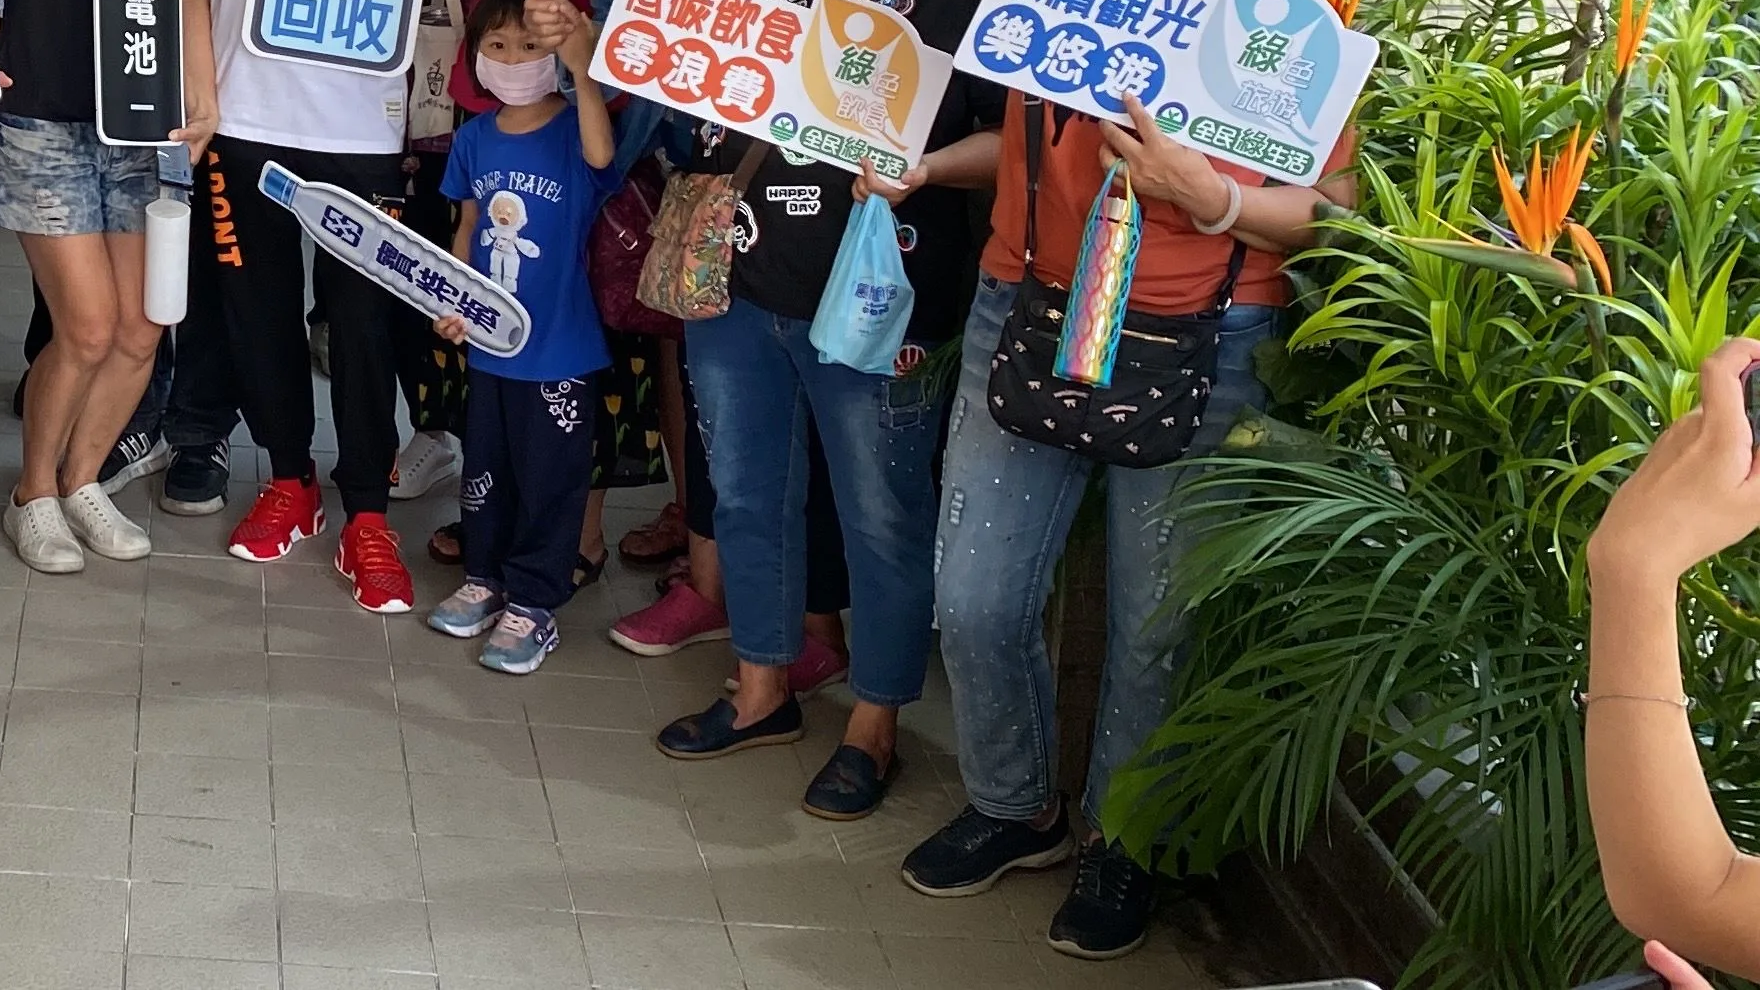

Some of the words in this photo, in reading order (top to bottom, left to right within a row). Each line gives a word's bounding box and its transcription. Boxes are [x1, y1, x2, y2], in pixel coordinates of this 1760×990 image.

[613, 26, 766, 117] 零浪費
[835, 45, 902, 101] 綠色
[978, 11, 1159, 101] 樂悠遊
[1237, 27, 1317, 89] 綠色
[835, 91, 891, 133] 飲食
[1229, 80, 1302, 127] 旅遊
[801, 127, 905, 178] 全民綠生活
[1191, 121, 1312, 175] 全民綠生活
[508, 171, 563, 203] TRAVEL
[767, 187, 820, 200] HAPPY
[788, 201, 820, 214] DAY
